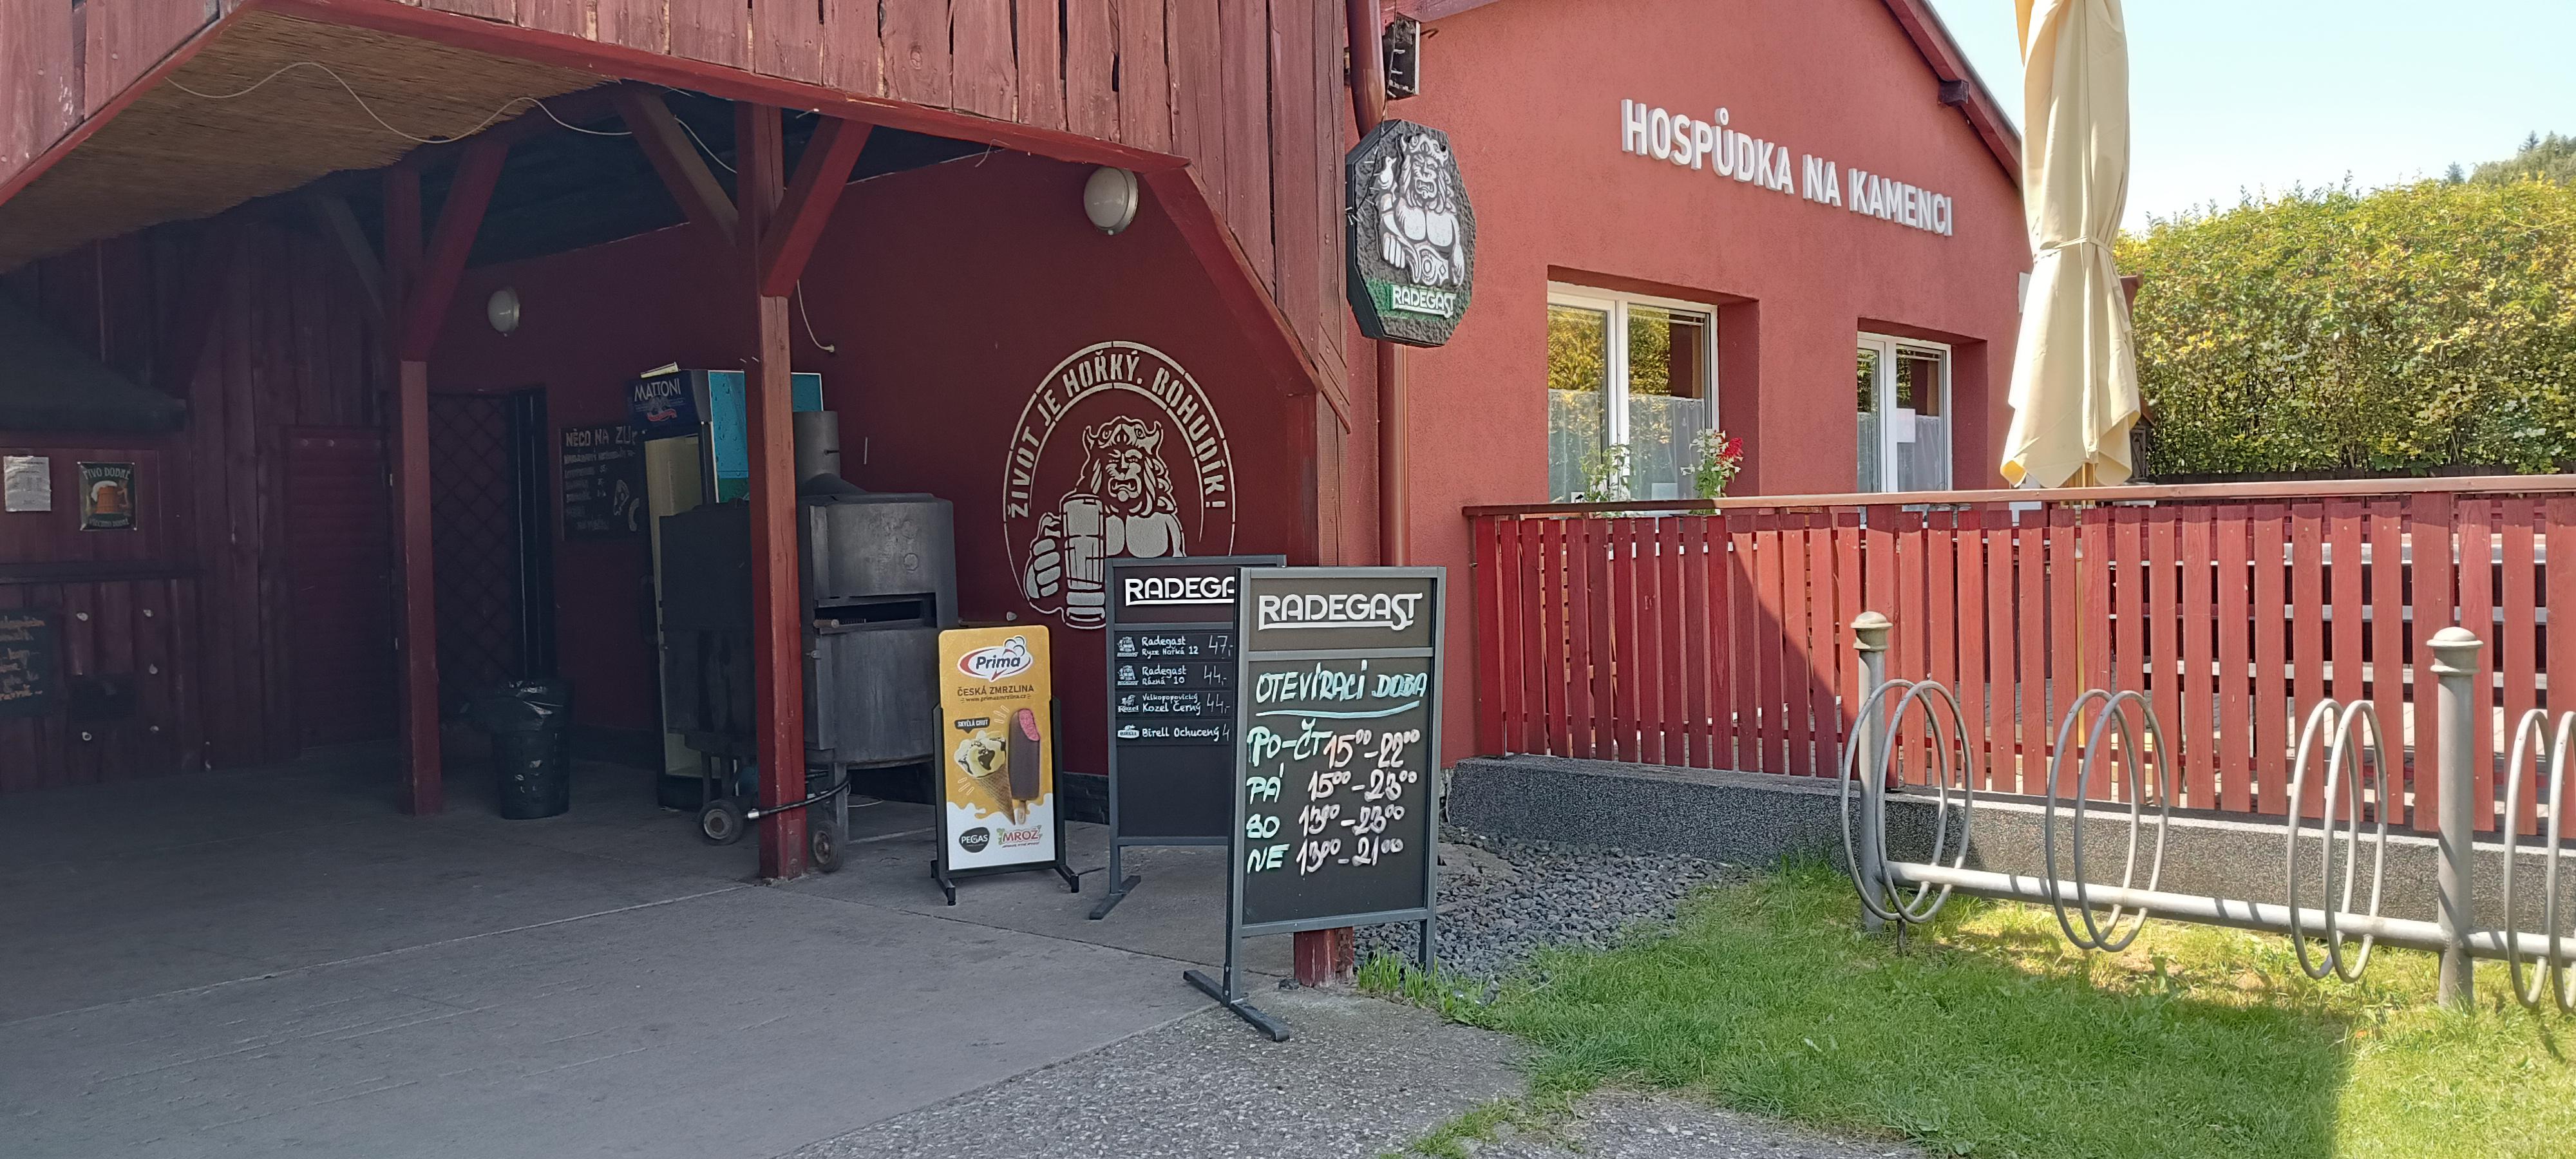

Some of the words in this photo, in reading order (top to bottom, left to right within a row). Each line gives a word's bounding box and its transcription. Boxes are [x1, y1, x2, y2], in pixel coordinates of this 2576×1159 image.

[1621, 98, 1794, 194] HOSPŮDKA
[1803, 154, 1842, 207] NA
[1848, 167, 1953, 236] KAMENCI
[1392, 284, 1457, 319] RADEGAST
[634, 377, 681, 402] MATTONI
[594, 429, 610, 446] NA
[1008, 426, 1040, 518] ŽIVOT
[1037, 389, 1061, 426] JE
[1124, 576, 1235, 607] RADEGA
[1258, 592, 1423, 632] RADEGAST
[1141, 635, 1186, 649] Radegast
[1188, 646, 1199, 655] 12
[976, 654, 1021, 670] Prima
[1142, 663, 1188, 679] Radegast
[957, 685, 987, 697] ČESKÁ
[989, 684, 1034, 695] ZMRZLINA
[1371, 672, 1428, 698] DOBA
[1142, 702, 1170, 712] Kozel
[1172, 700, 1202, 715] Černý
[1142, 727, 1170, 737] Birell
[1173, 726, 1220, 742] Ochucený
[961, 834, 989, 844] PEGAS
[1247, 843, 1291, 874] NE
